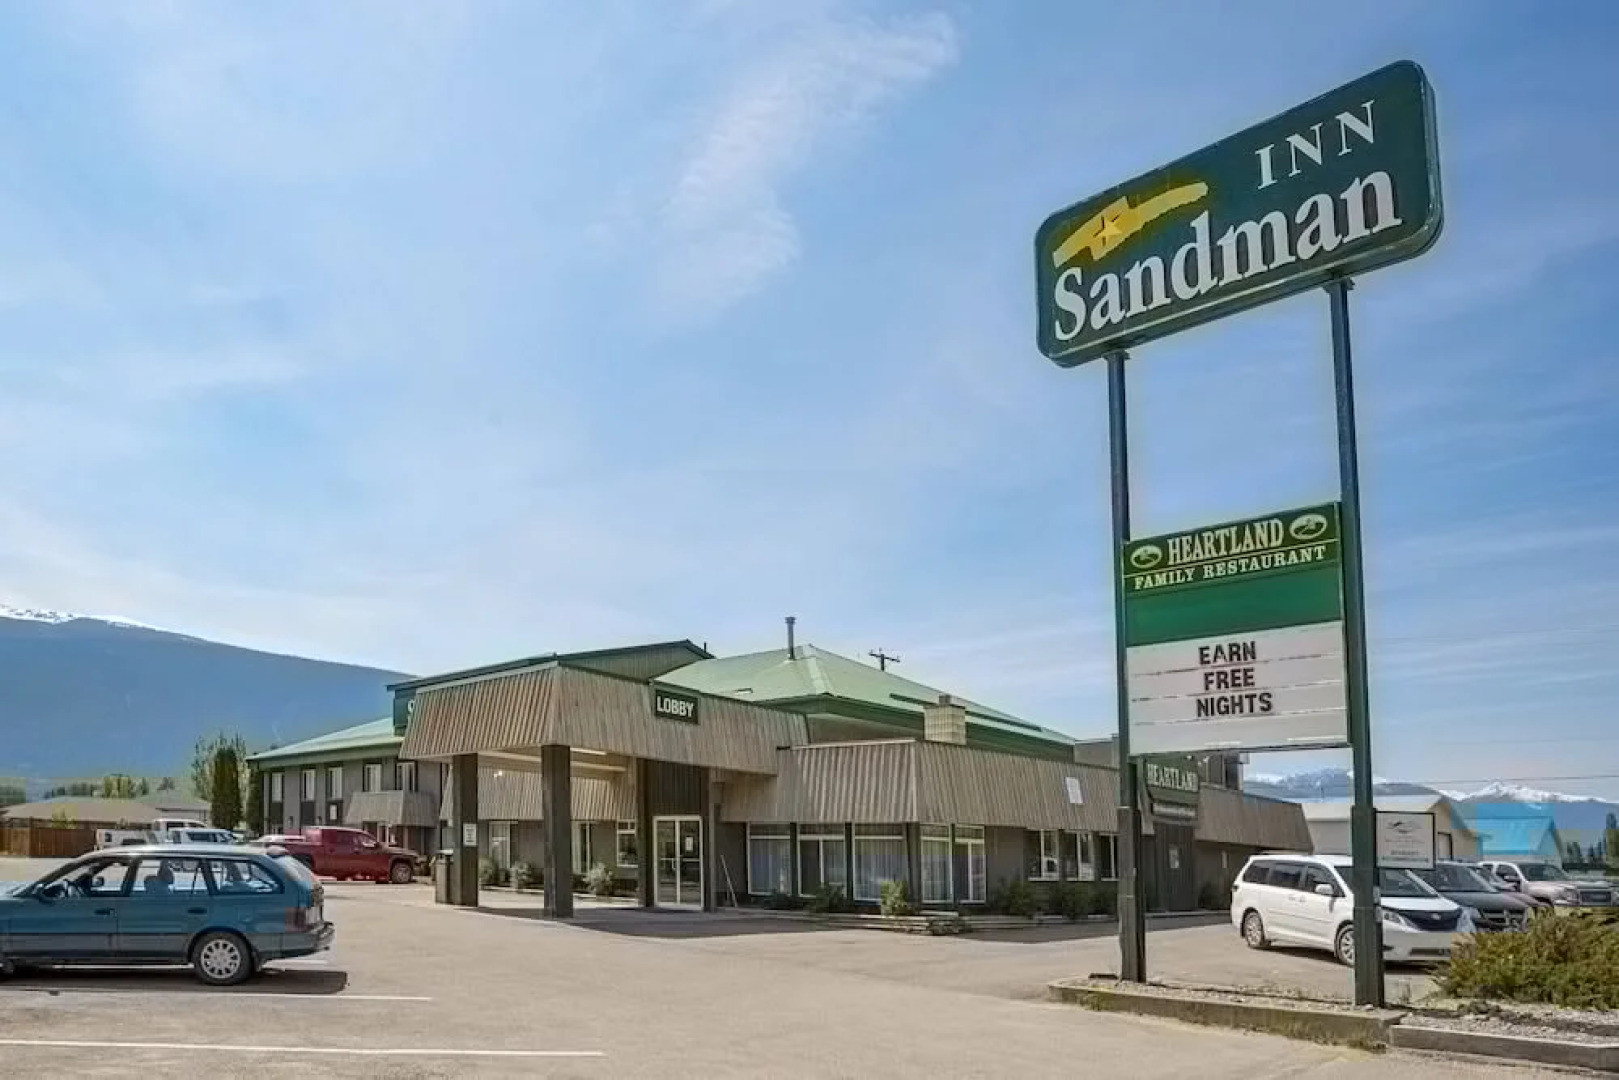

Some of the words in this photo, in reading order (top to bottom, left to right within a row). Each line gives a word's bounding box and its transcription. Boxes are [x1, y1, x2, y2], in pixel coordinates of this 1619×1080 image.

[1255, 101, 1375, 189] INN
[1054, 170, 1402, 341] Sandman
[1167, 518, 1285, 566] HEARTLAND
[1134, 568, 1195, 590] FAMILY
[1203, 545, 1326, 579] RESTAURANT
[1198, 641, 1257, 666] EARN
[1203, 667, 1256, 691] FREE
[657, 696, 693, 717] LOBBY
[1196, 692, 1273, 718] NIGHTS
